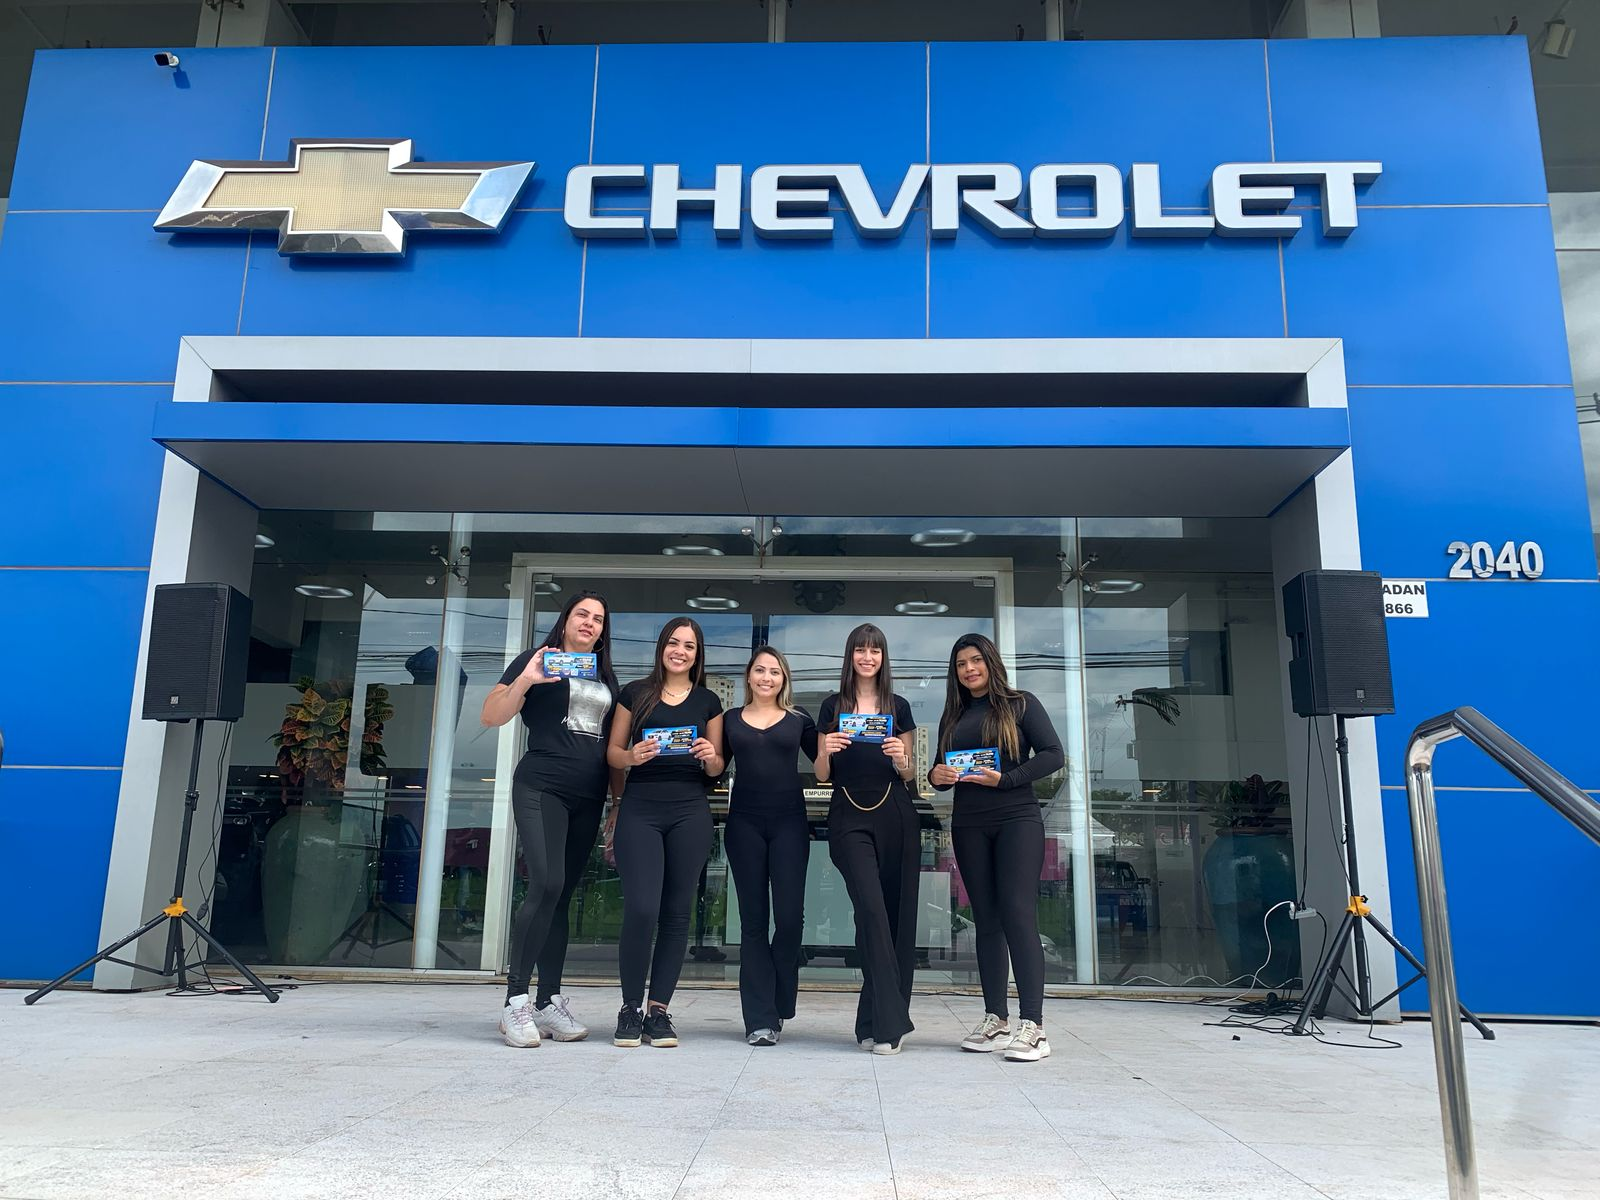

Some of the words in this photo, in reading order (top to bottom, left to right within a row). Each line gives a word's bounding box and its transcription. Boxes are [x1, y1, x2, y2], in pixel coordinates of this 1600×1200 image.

[564, 161, 1384, 238] CHEVROLET
[1447, 541, 1544, 580] 2040
[1382, 584, 1425, 595] ADAN
[1385, 603, 1414, 614] 866
